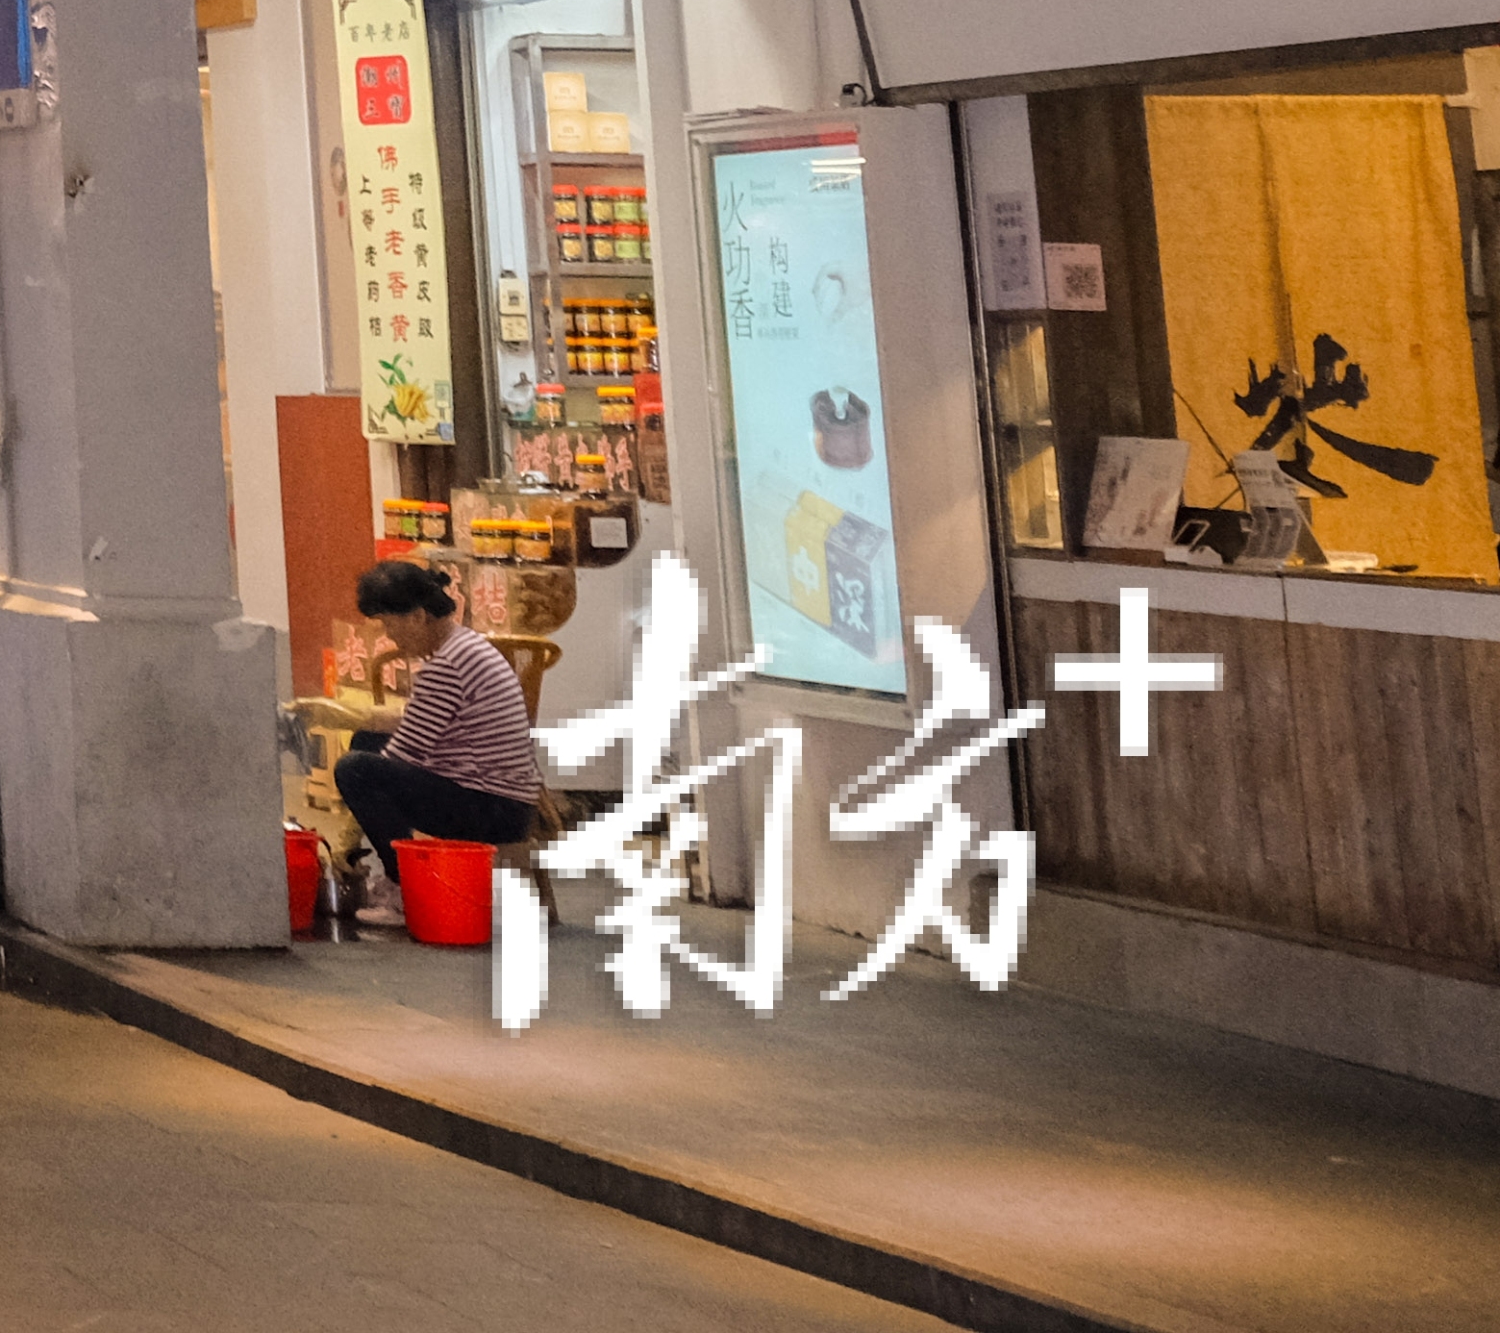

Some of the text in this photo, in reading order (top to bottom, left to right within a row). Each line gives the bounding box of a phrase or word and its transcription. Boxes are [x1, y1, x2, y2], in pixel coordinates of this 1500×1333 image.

[348, 20, 411, 43] 百年老店
[377, 145, 410, 343] 佛手老香黄
